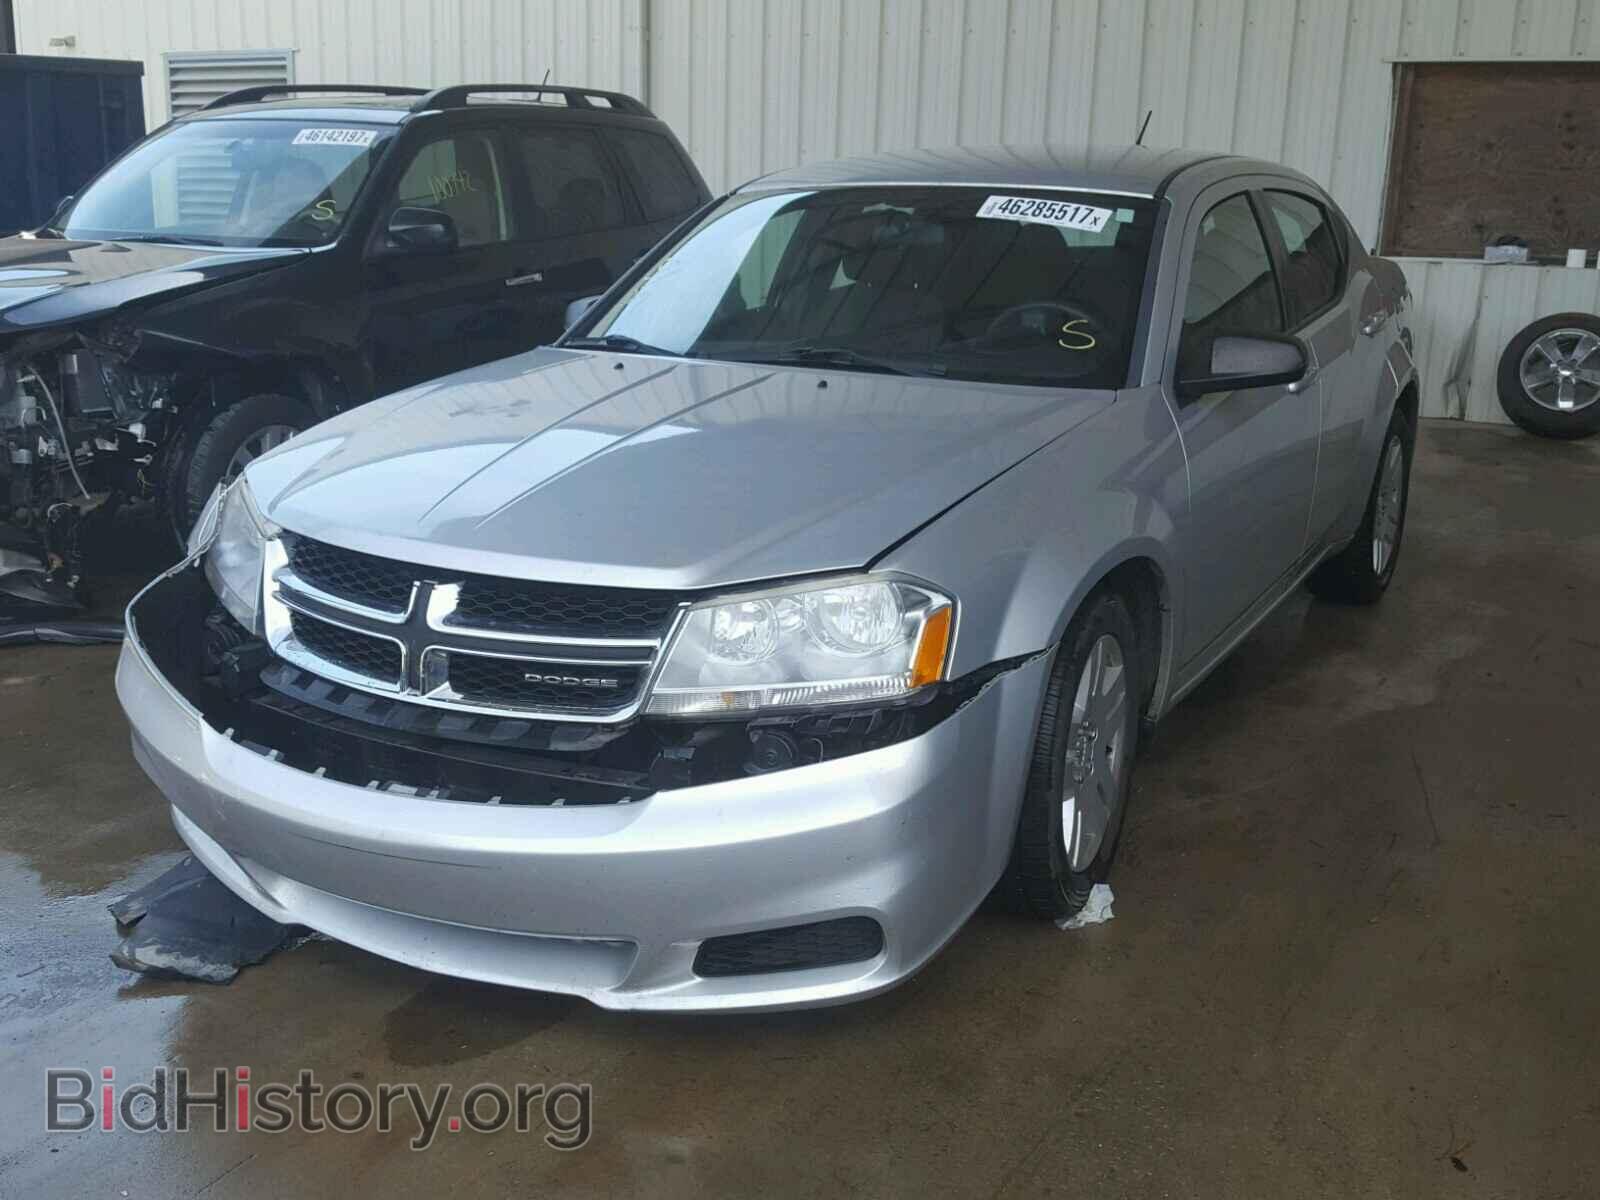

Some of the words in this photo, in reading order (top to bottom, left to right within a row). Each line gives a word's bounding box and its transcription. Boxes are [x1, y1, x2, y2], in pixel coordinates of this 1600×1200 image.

[312, 200, 337, 220] S
[1059, 320, 1095, 349] S
[525, 673, 618, 688] DODGE
